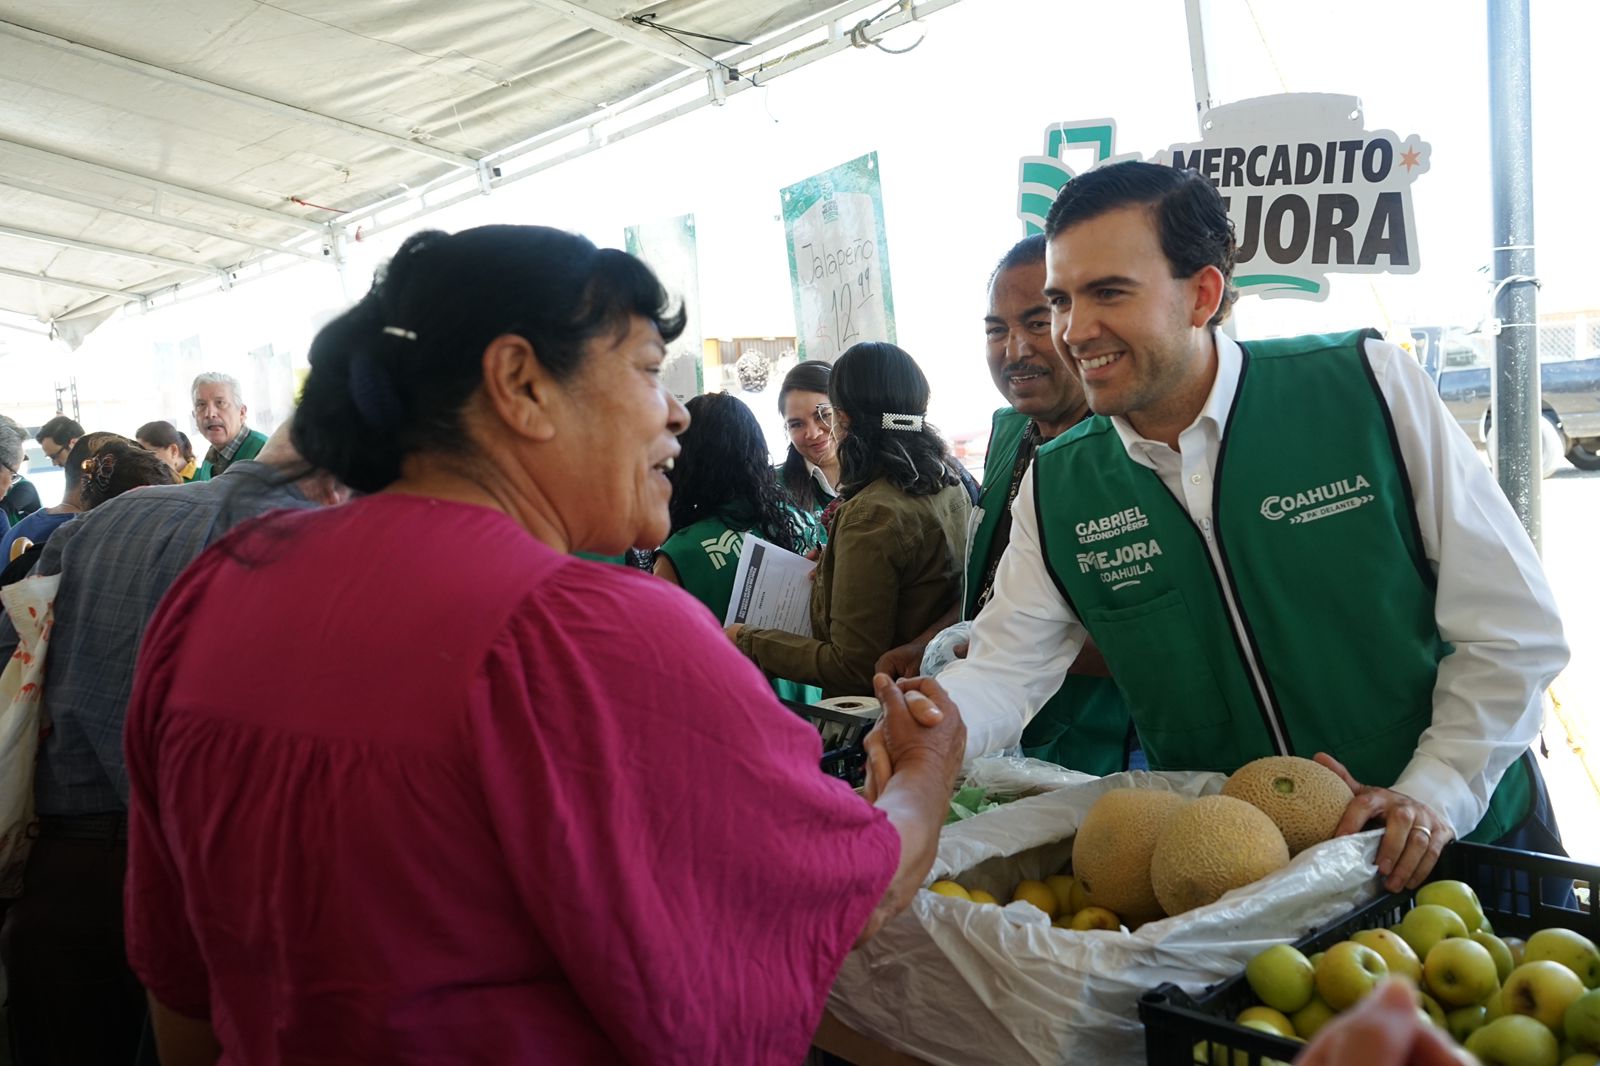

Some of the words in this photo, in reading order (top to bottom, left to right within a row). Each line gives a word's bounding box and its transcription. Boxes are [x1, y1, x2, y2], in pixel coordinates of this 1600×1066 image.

[1225, 191, 1410, 266] JORA
[801, 238, 874, 285] Jalapeño
[1260, 474, 1371, 521] COAHUILA
[1320, 499, 1356, 515] DELANTE
[1075, 506, 1146, 536] GABRIEL
[1078, 528, 1120, 544] ELIZONDO
[1076, 539, 1162, 573] MEJORA
[1100, 562, 1154, 582] COAHUILA
